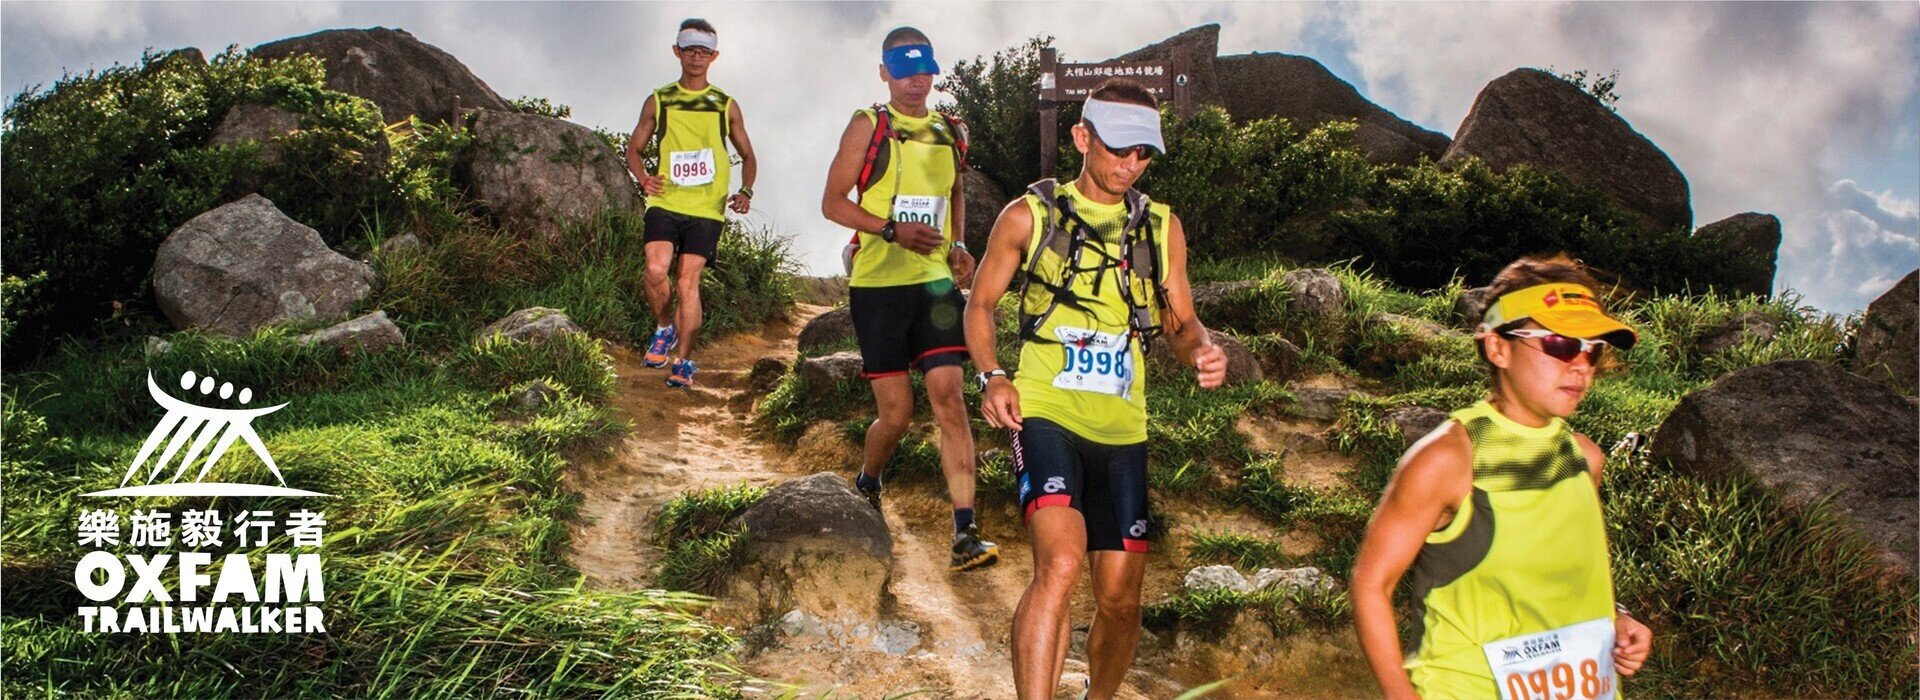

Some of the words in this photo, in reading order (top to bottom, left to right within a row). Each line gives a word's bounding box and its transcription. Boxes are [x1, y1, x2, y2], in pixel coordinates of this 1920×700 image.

[673, 161, 708, 178] 0998
[1063, 346, 1125, 378] 0998
[1523, 640, 1561, 656] OXFAM
[1506, 658, 1600, 700] 0998
